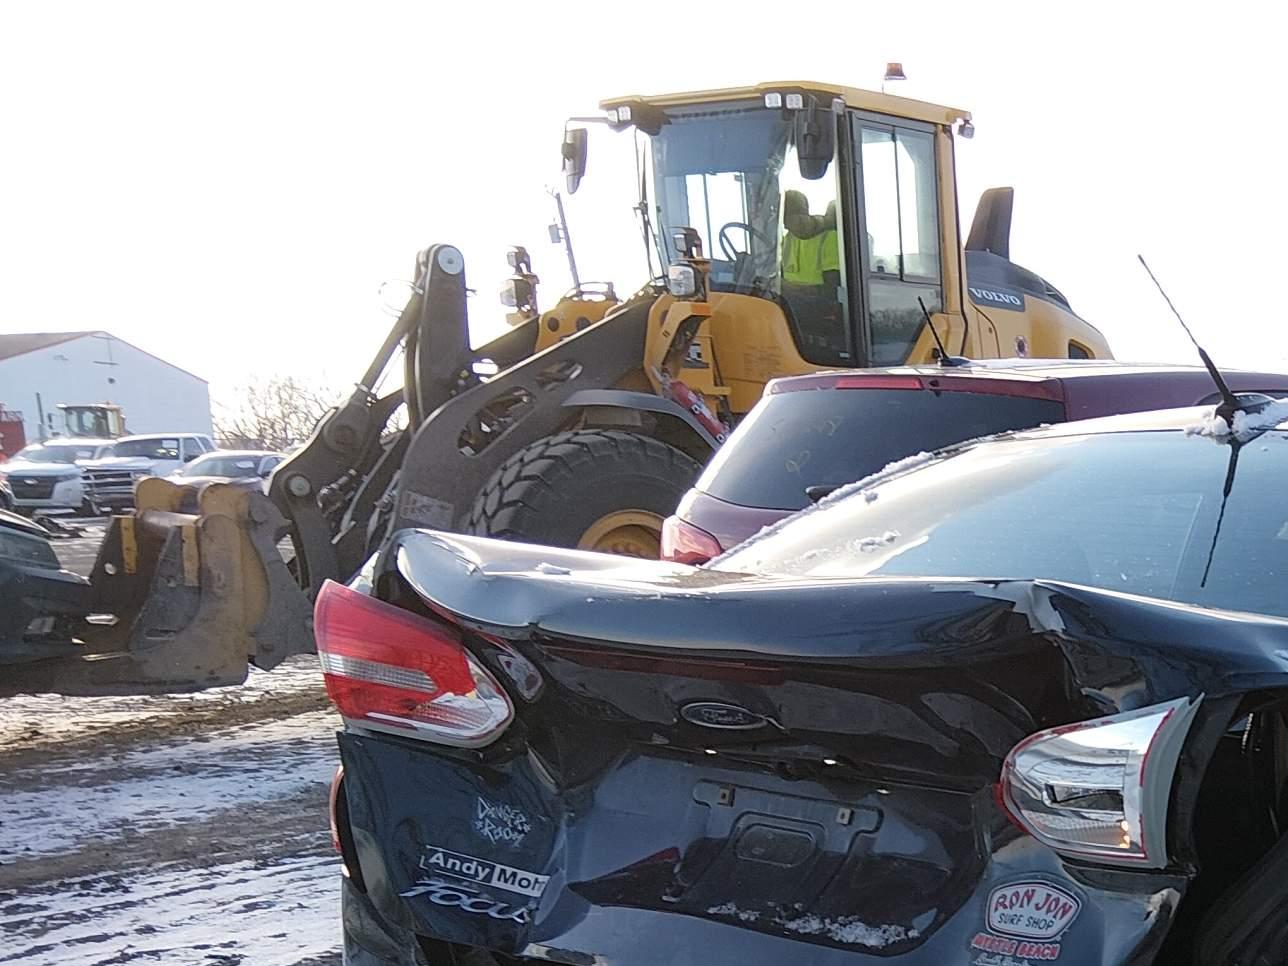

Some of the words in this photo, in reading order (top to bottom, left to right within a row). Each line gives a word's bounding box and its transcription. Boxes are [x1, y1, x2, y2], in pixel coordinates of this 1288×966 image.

[969, 287, 1022, 305] VOLVO
[428, 852, 491, 881] Andy
[994, 889, 1036, 913] RON
[1034, 893, 1073, 921] JON
[998, 913, 1023, 926] SURF
[1025, 916, 1055, 930] SHOP
[1016, 942, 1061, 960] BEACH
